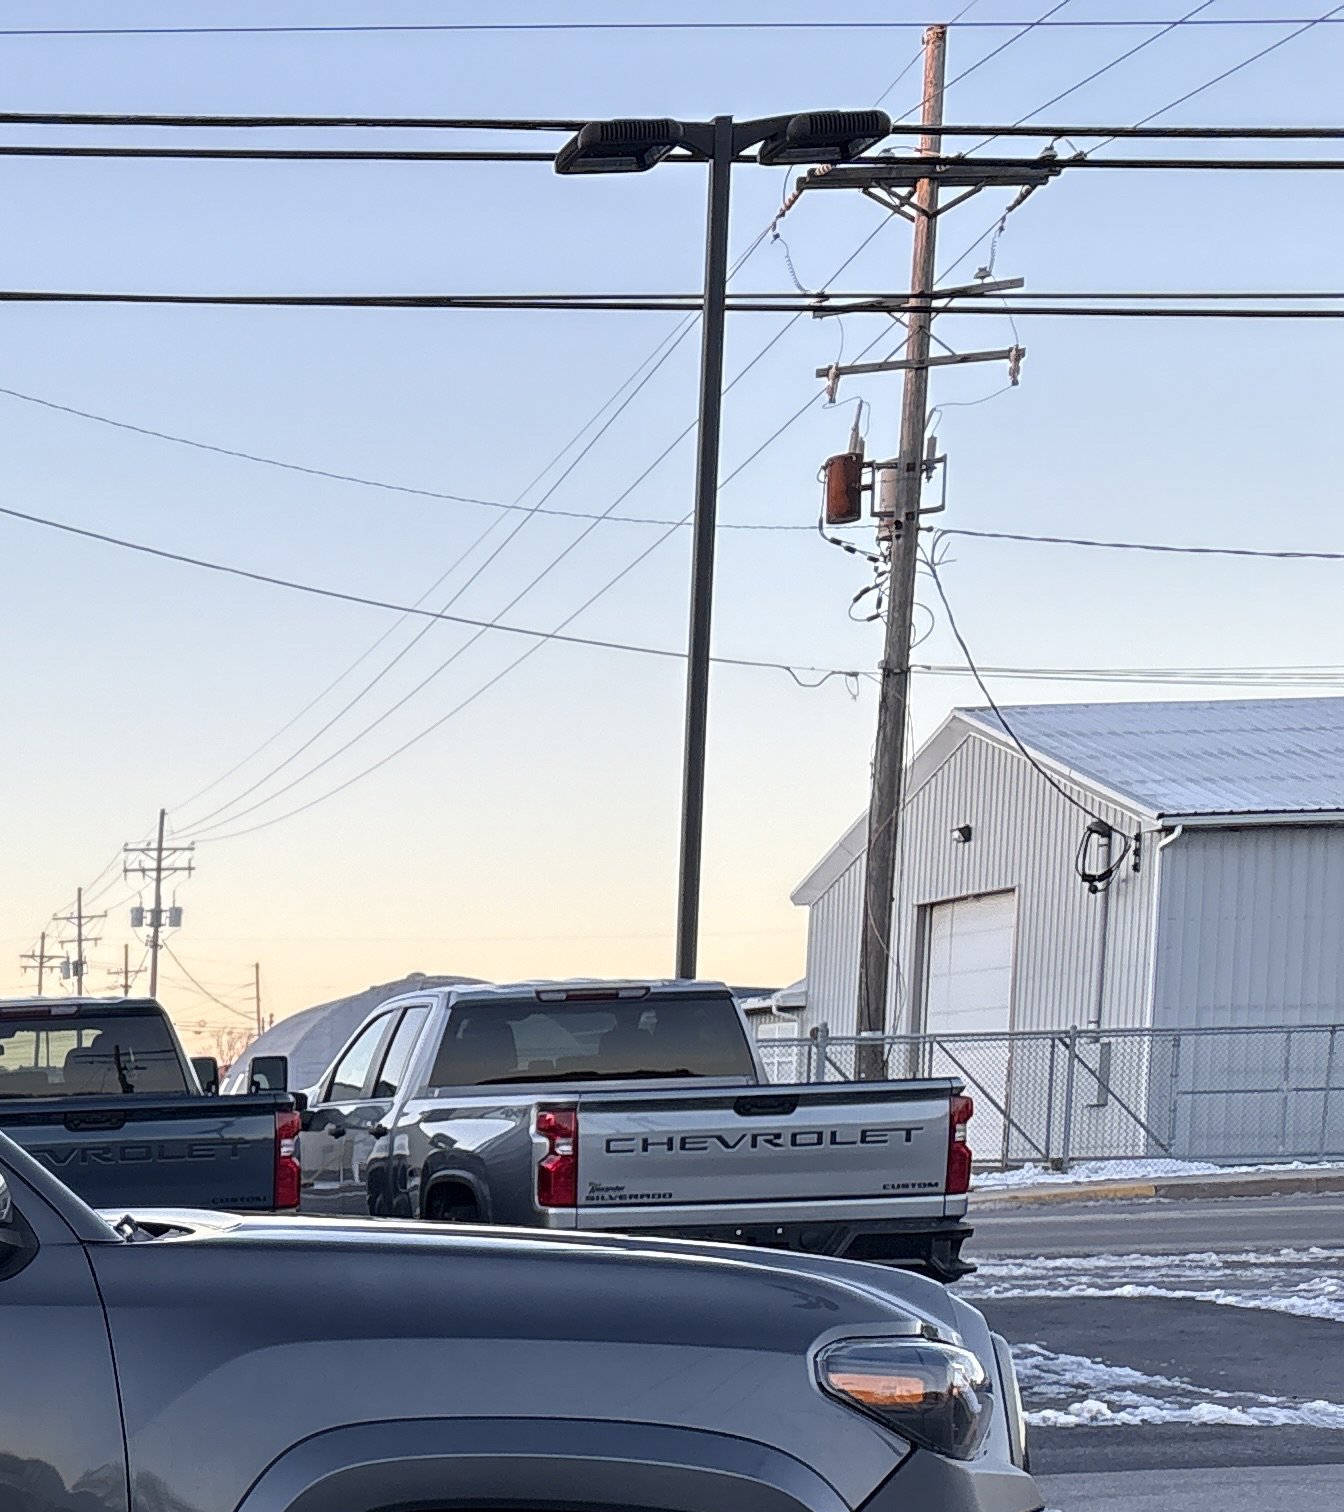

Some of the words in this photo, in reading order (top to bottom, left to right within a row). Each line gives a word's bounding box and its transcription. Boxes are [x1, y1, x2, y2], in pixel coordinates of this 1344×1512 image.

[604, 1126, 924, 1153] CHEVROLET
[30, 1142, 251, 1167] VROLET
[882, 1181, 939, 1190] CUSTOM
[585, 1192, 673, 1201] SILVERADO
